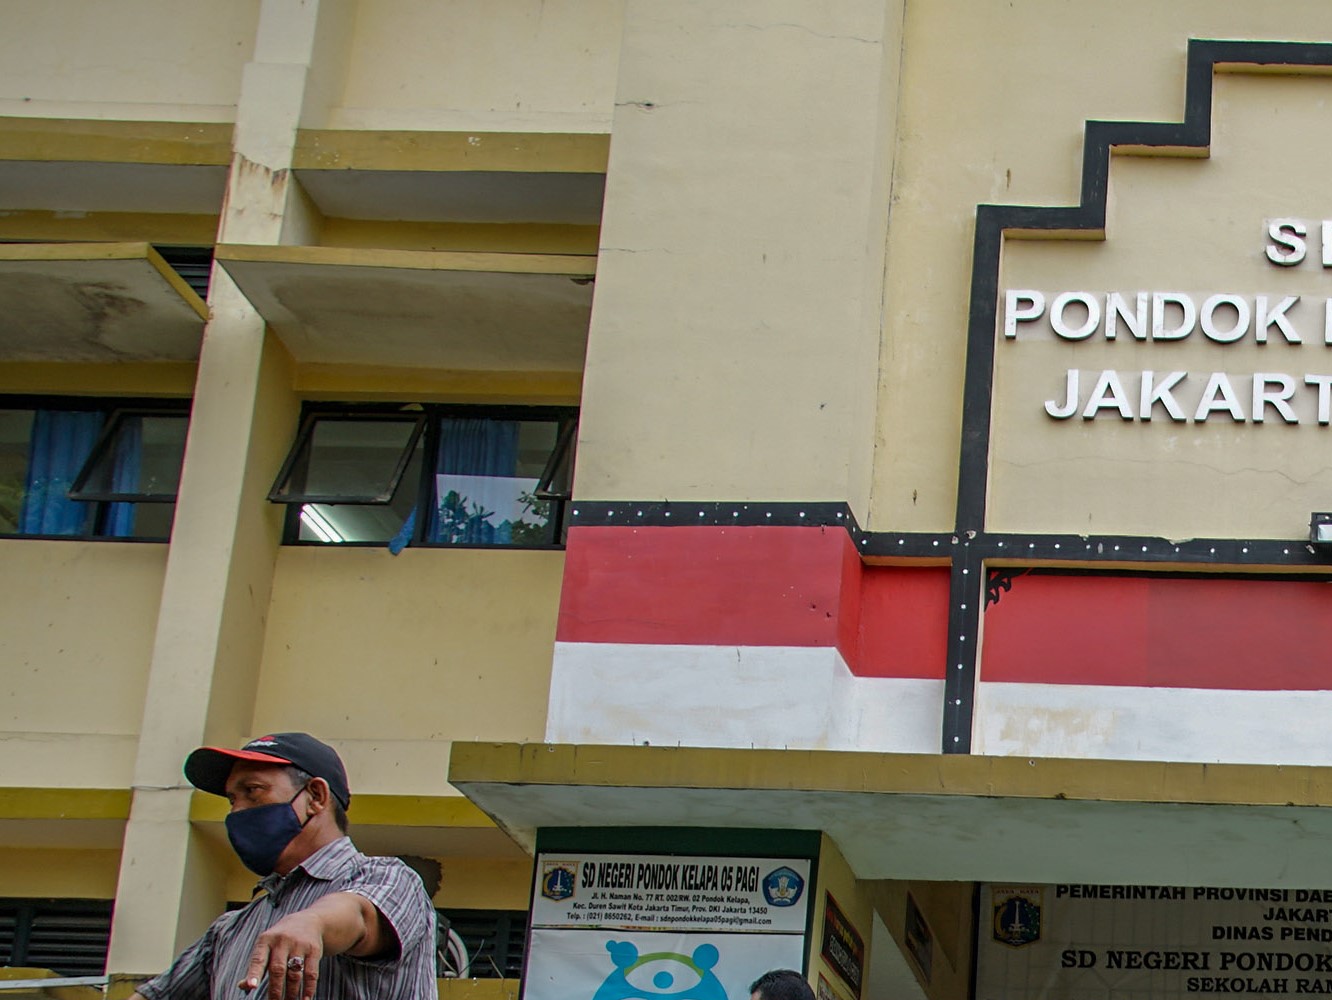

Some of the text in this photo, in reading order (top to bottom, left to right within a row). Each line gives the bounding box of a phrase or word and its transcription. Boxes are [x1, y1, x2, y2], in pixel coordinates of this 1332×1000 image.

[1003, 289, 1302, 345] PONDOK
[581, 862, 760, 893] SD NEGERI PONDOK KELAPA 05 PAGI
[591, 892, 600, 900] Jl.
[609, 893, 632, 901] Naman
[633, 893, 643, 901] No.
[645, 893, 654, 901] 77
[692, 894, 700, 902] 02
[701, 895, 725, 903] Pondok
[726, 896, 751, 905] Kelapa,
[1056, 884, 1186, 901] PEMERINTAH
[1193, 886, 1289, 902] PROVINSI
[573, 902, 586, 910] Kec.
[608, 903, 627, 911] Sawit
[645, 904, 669, 912] Jakarta
[671, 905, 690, 913] Timur,
[691, 905, 707, 913] Prov.
[748, 907, 768, 915] 13450
[587, 912, 603, 921] (021)
[634, 914, 655, 922] E-mail
[1211, 926, 1274, 941] DINAS
[1061, 949, 1097, 969] SD
[1105, 950, 1210, 971] NEGERI
[1186, 976, 1288, 993] SEKOLAH
